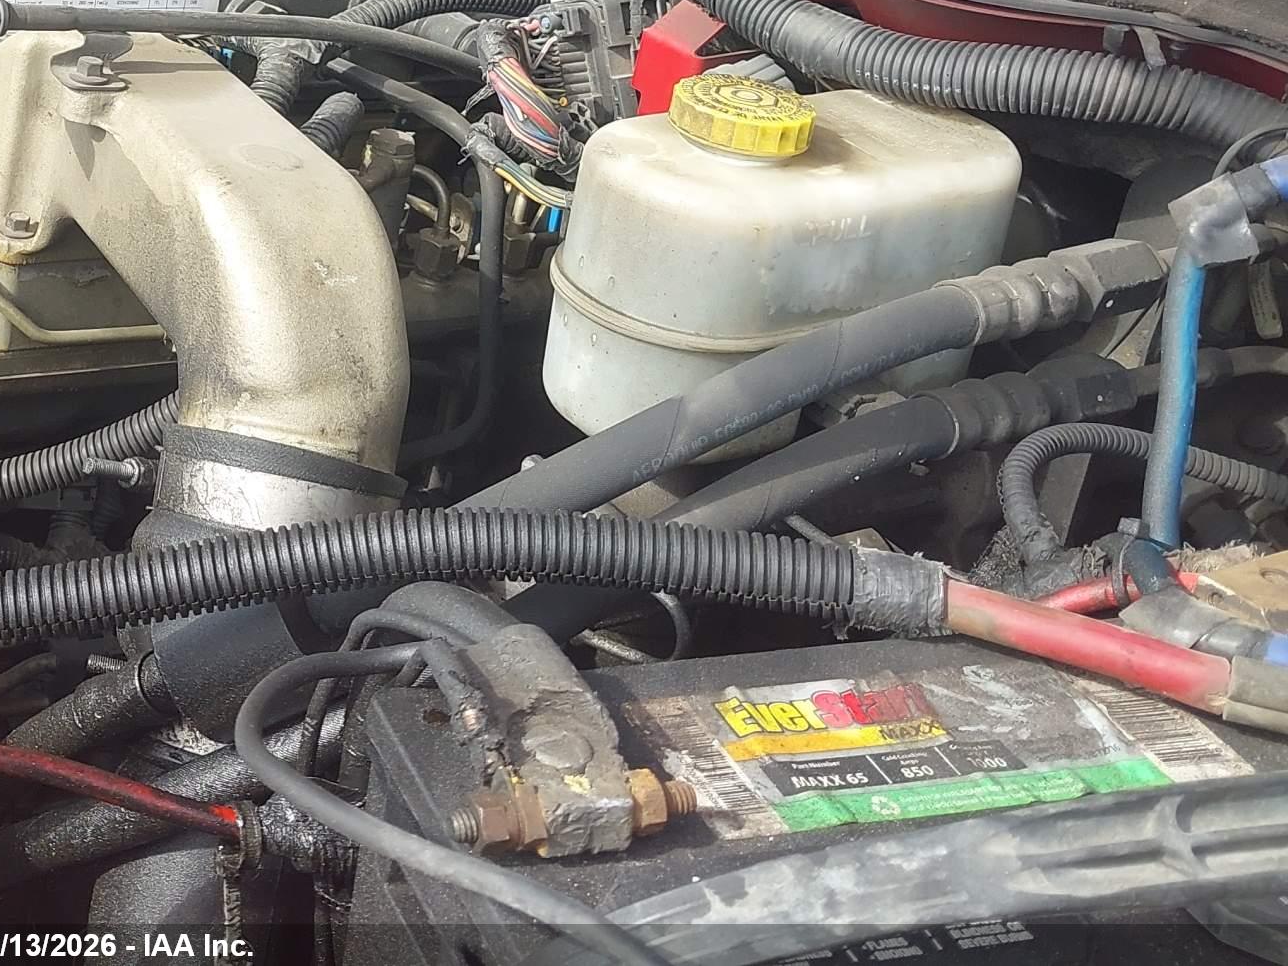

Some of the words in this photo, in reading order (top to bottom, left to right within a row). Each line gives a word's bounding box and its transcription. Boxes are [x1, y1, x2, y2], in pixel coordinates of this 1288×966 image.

[900, 765, 934, 779] 850
[791, 774, 846, 790] MAXX
[846, 772, 869, 785] 65
